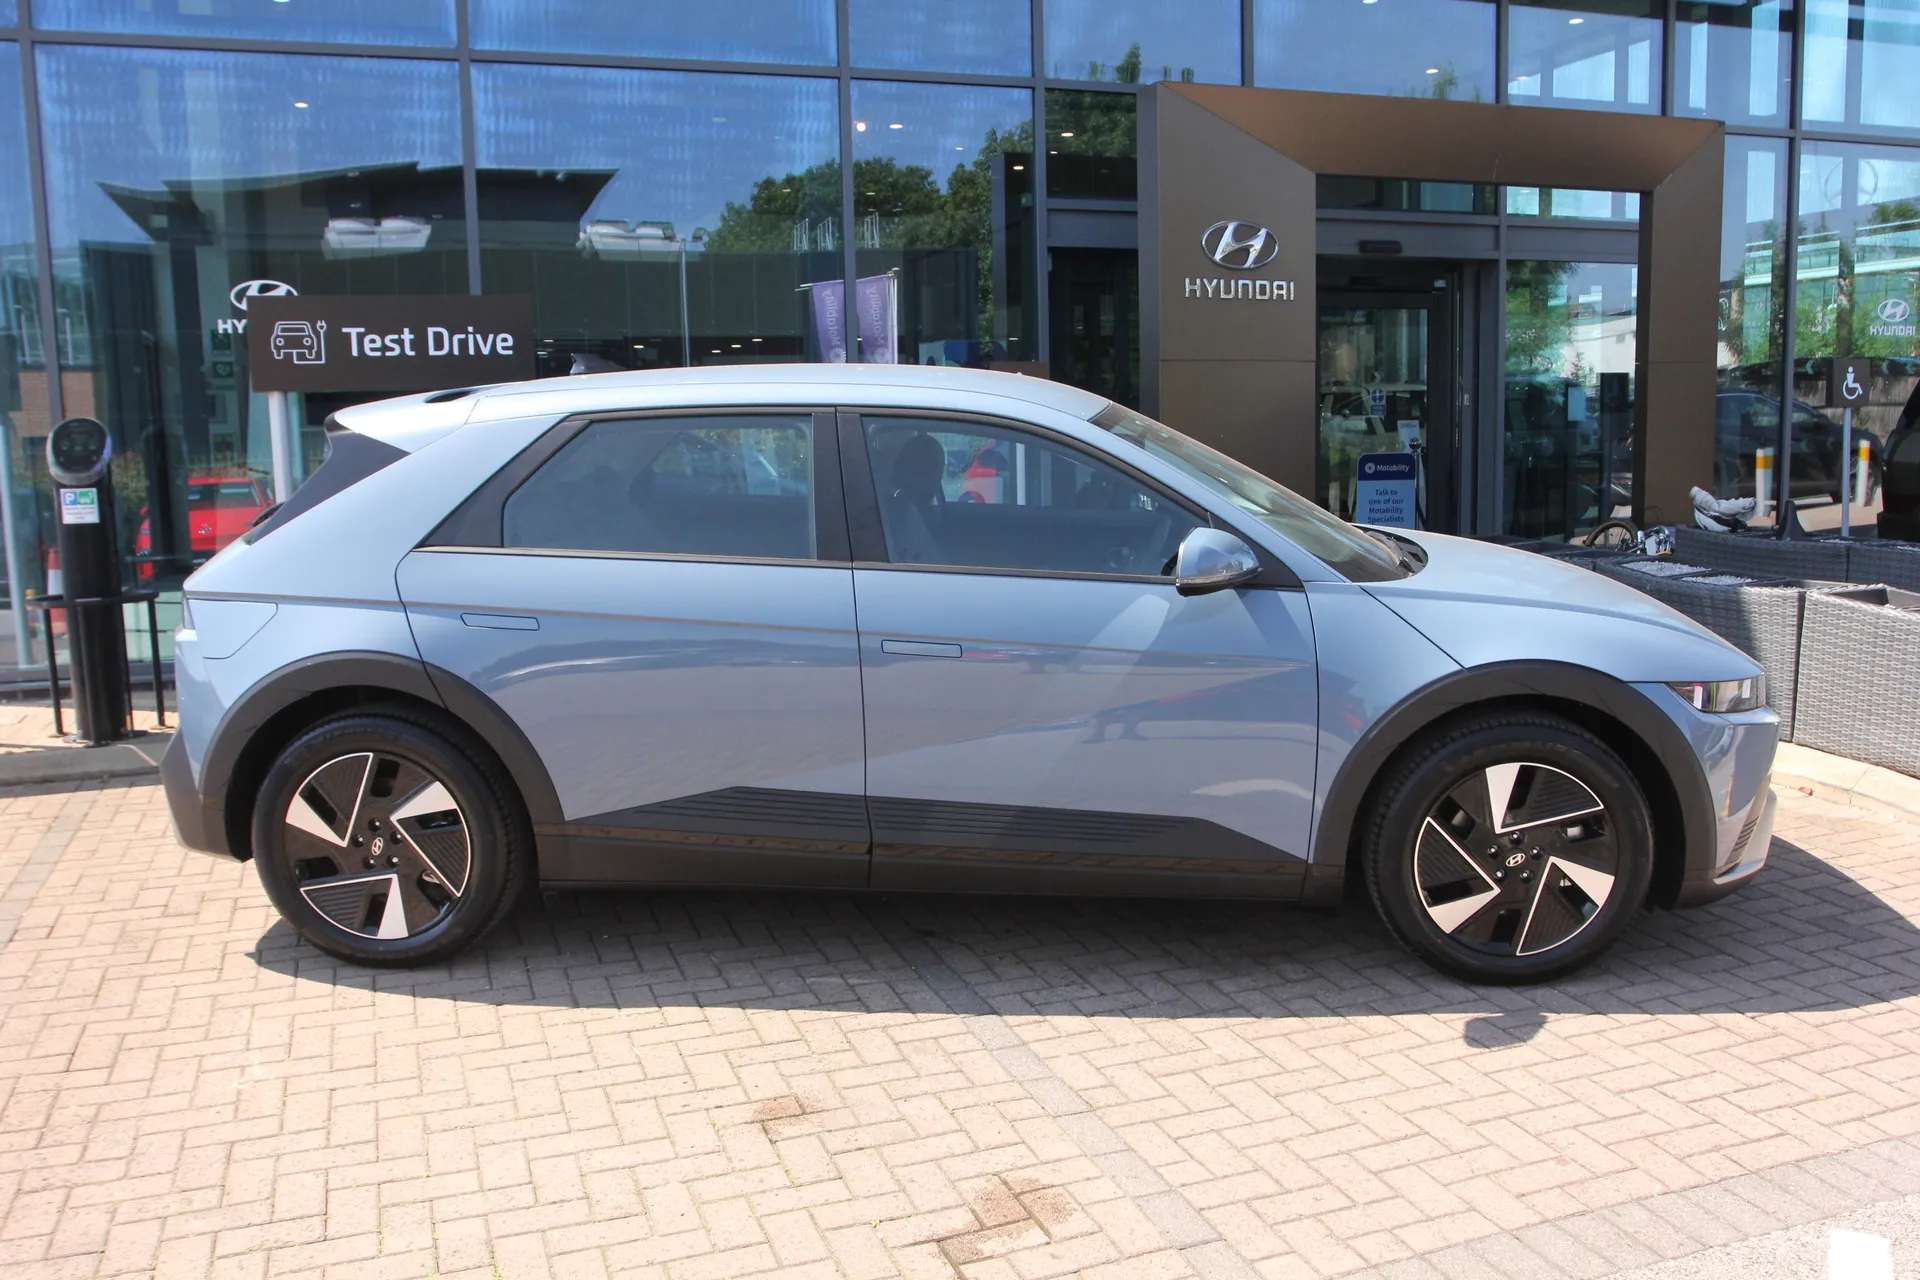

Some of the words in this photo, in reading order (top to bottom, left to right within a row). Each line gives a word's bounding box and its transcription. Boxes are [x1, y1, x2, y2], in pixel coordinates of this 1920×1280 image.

[1184, 277, 1295, 301] HYUNDAI
[1869, 325, 1916, 337] HYUNDAI
[342, 326, 416, 357] Test
[427, 325, 513, 356] Drive
[1376, 464, 1409, 472] Motability
[1375, 488, 1389, 496] Talk
[1383, 497, 1391, 505] of
[1368, 506, 1403, 515] Motability
